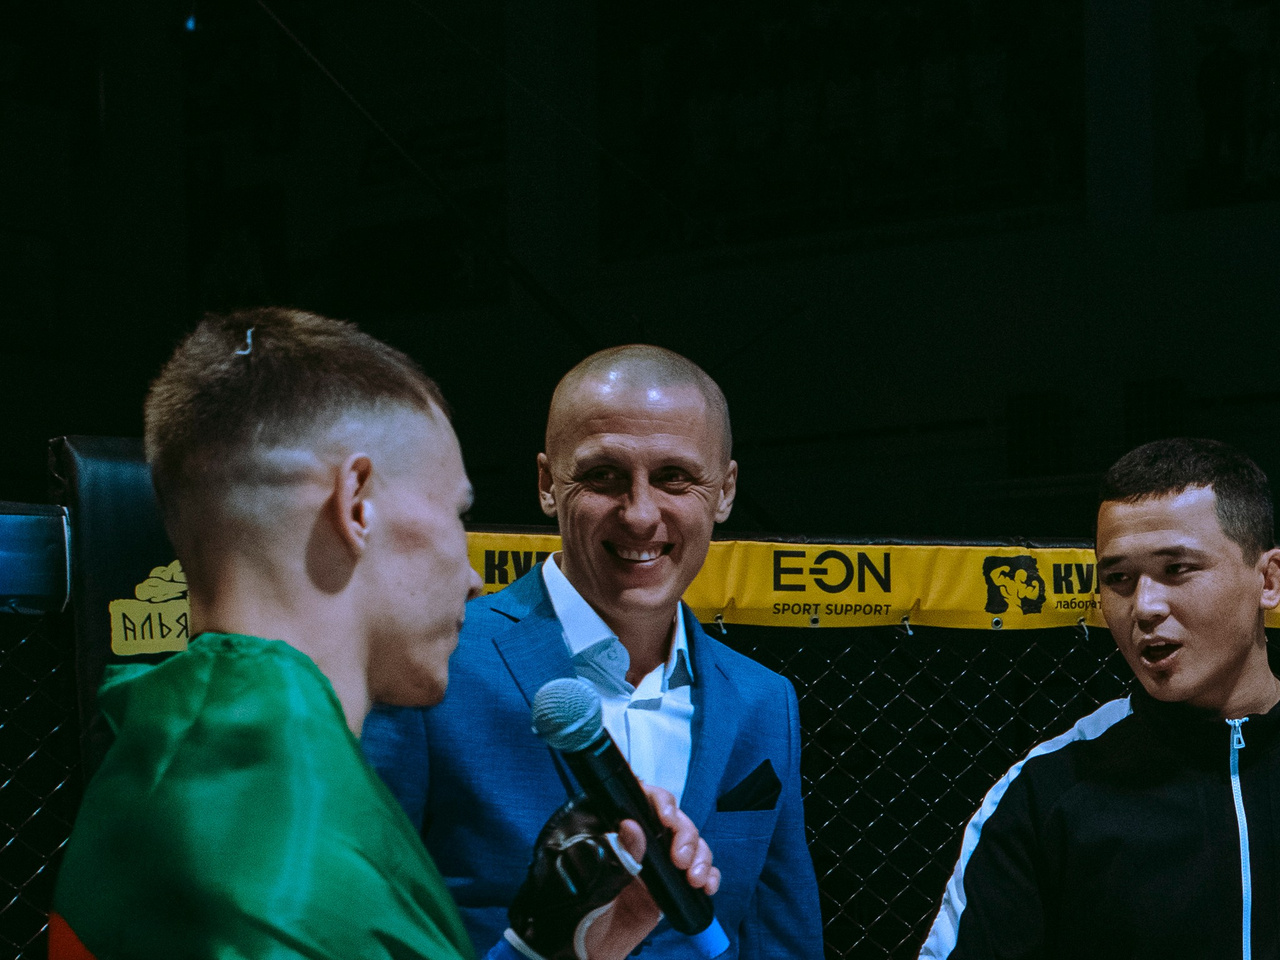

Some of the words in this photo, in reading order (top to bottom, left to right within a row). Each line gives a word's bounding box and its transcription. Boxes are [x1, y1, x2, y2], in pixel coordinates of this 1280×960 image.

[484, 550, 553, 585] КУ
[1053, 563, 1101, 594] КУ
[772, 602, 821, 616] SPORT
[825, 603, 892, 616] SUPPORT
